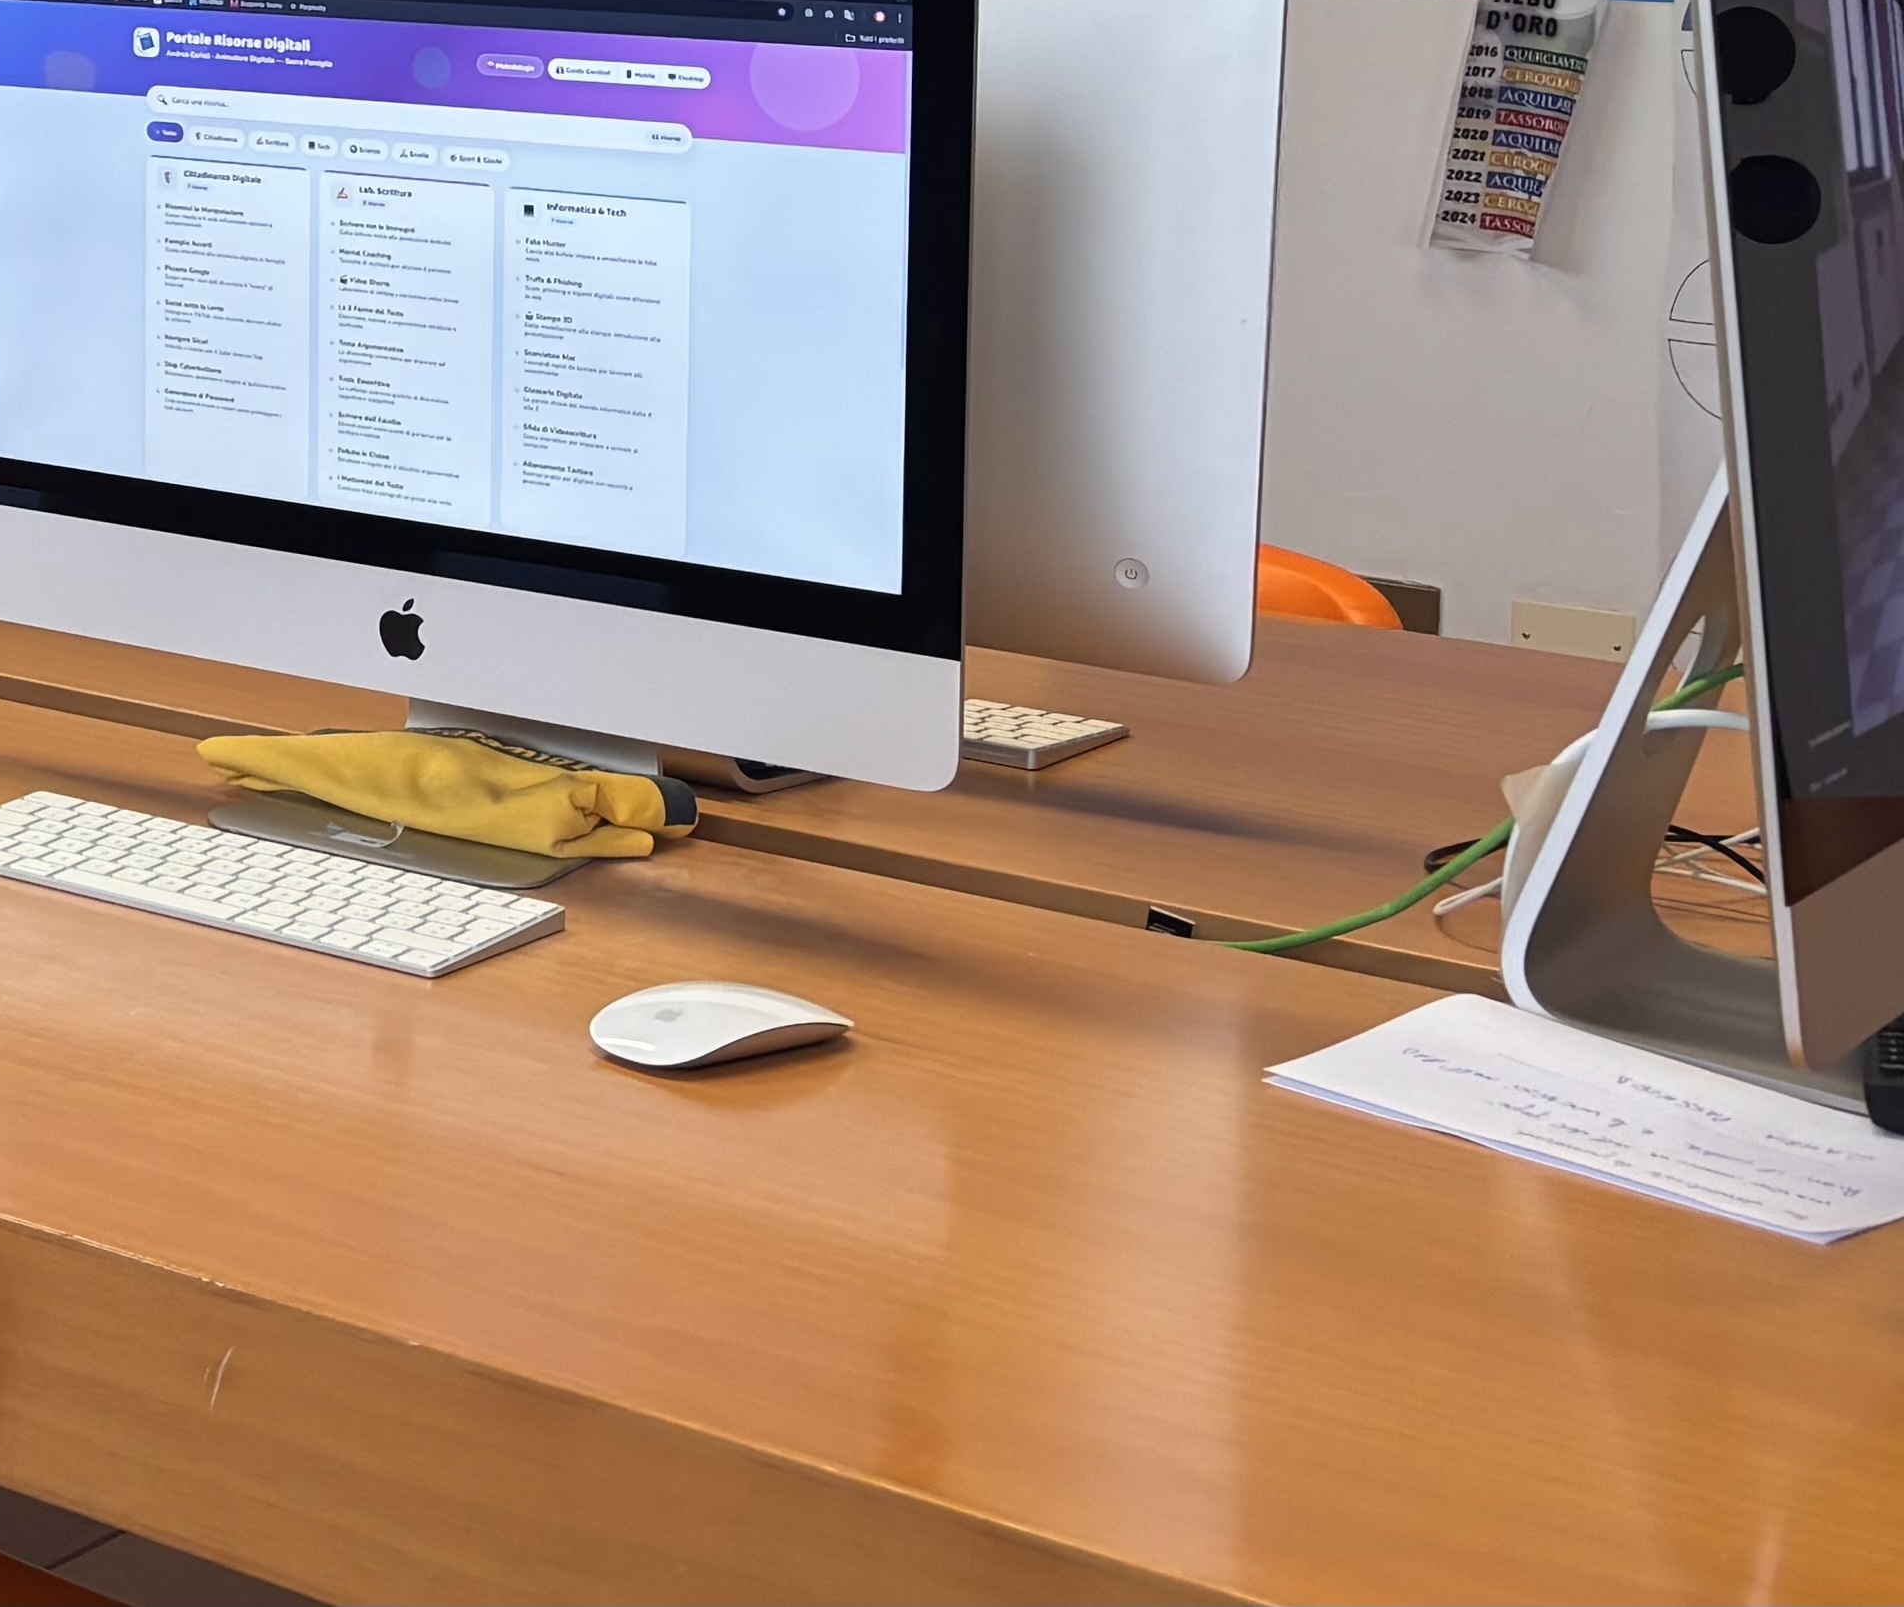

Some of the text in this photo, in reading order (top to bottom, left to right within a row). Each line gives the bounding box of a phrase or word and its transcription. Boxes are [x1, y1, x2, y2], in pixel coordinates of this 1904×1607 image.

[1485, 10, 1558, 38] D'ORO
[166, 31, 310, 54] Portale Risorse Digitali
[1464, 65, 1496, 78] 2017
[1460, 84, 1494, 99] 2018
[1456, 106, 1491, 119] 2019
[1453, 127, 1489, 141] 2020
[1452, 148, 1486, 162] 2021
[183, 170, 261, 185] Cittadinanza Digitale
[1446, 169, 1482, 183] 2022
[359, 186, 412, 197] Lab. Scrittura
[1444, 190, 1480, 204] 2023
[546, 202, 596, 214] Informatica
[606, 207, 626, 216] Tech
[1440, 210, 1476, 224] 2024
[553, 277, 582, 288] Phishing
